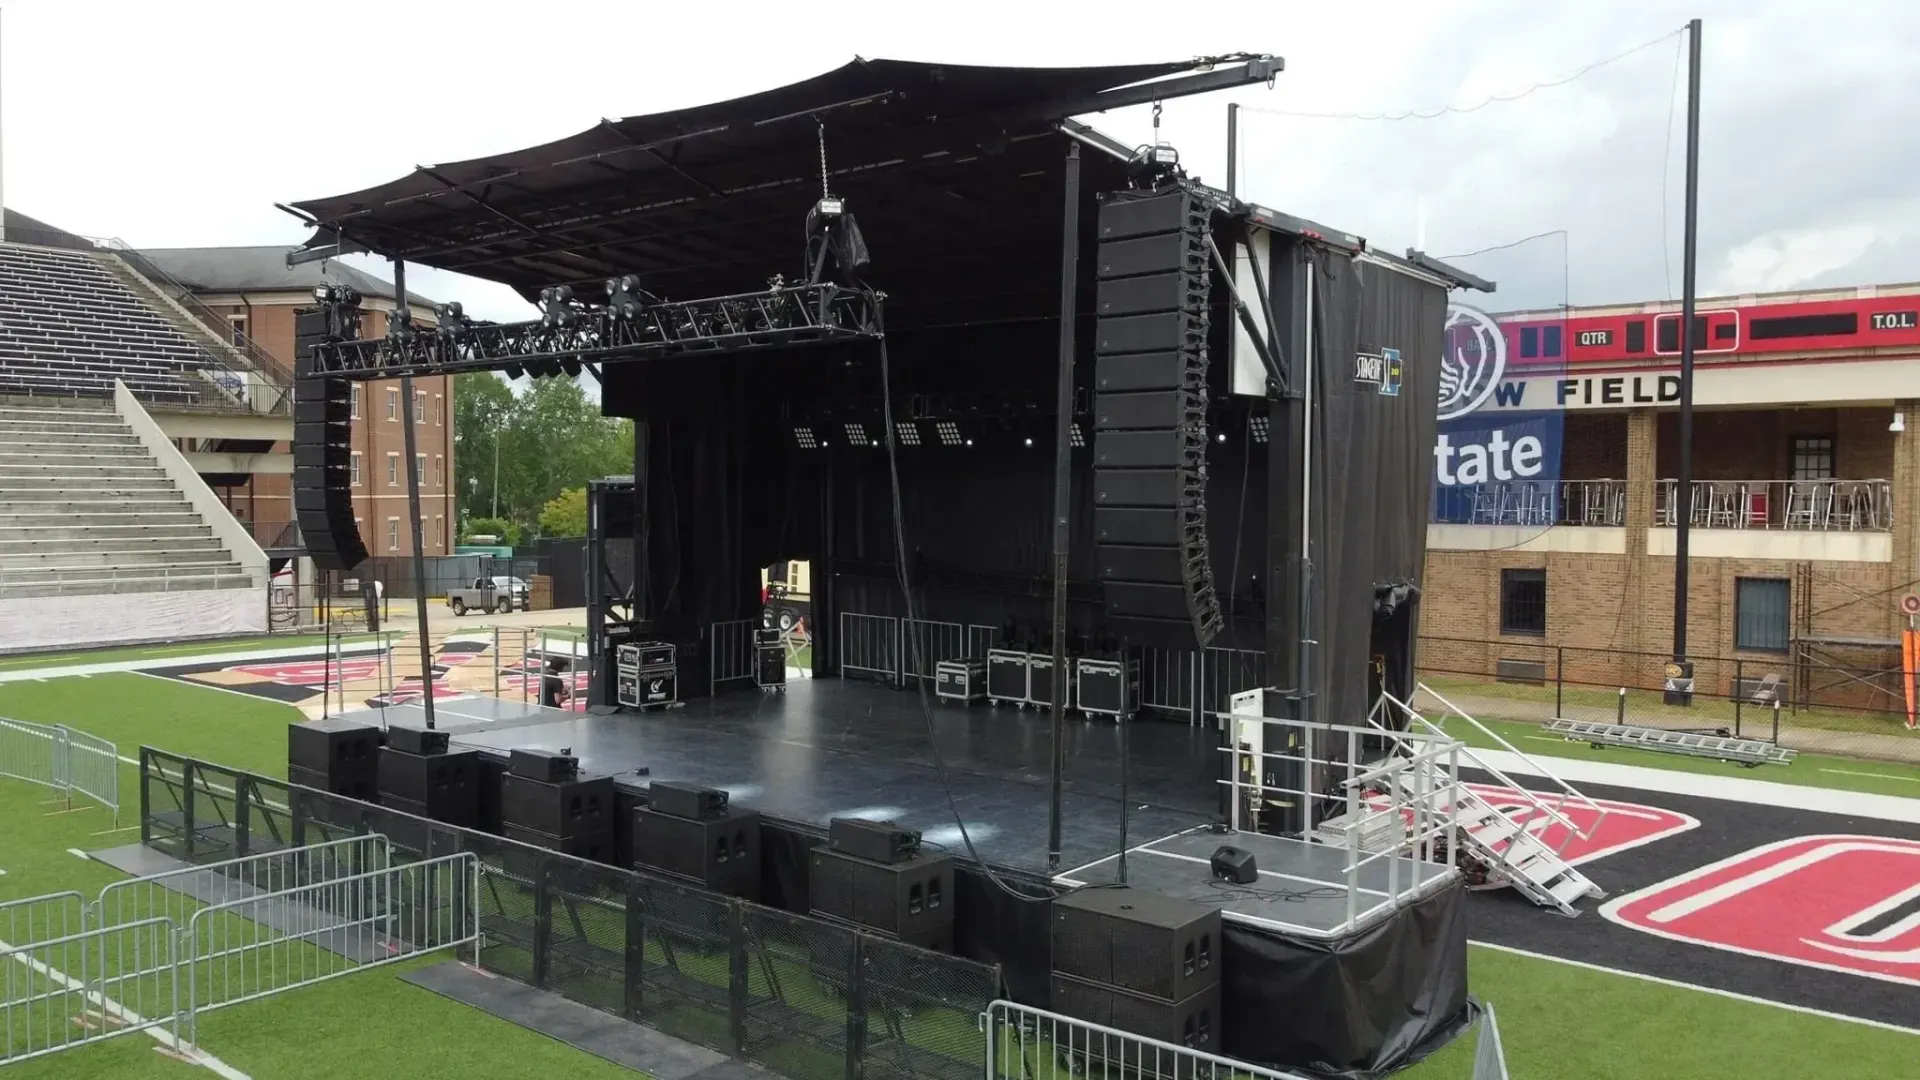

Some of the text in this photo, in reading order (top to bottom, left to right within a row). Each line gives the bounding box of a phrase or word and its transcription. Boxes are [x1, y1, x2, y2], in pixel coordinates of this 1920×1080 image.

[1873, 313, 1915, 329] T.O.L.
[1581, 331, 1607, 345] QTR
[1557, 375, 1682, 405] FIELD
[1433, 430, 1542, 485] tate
